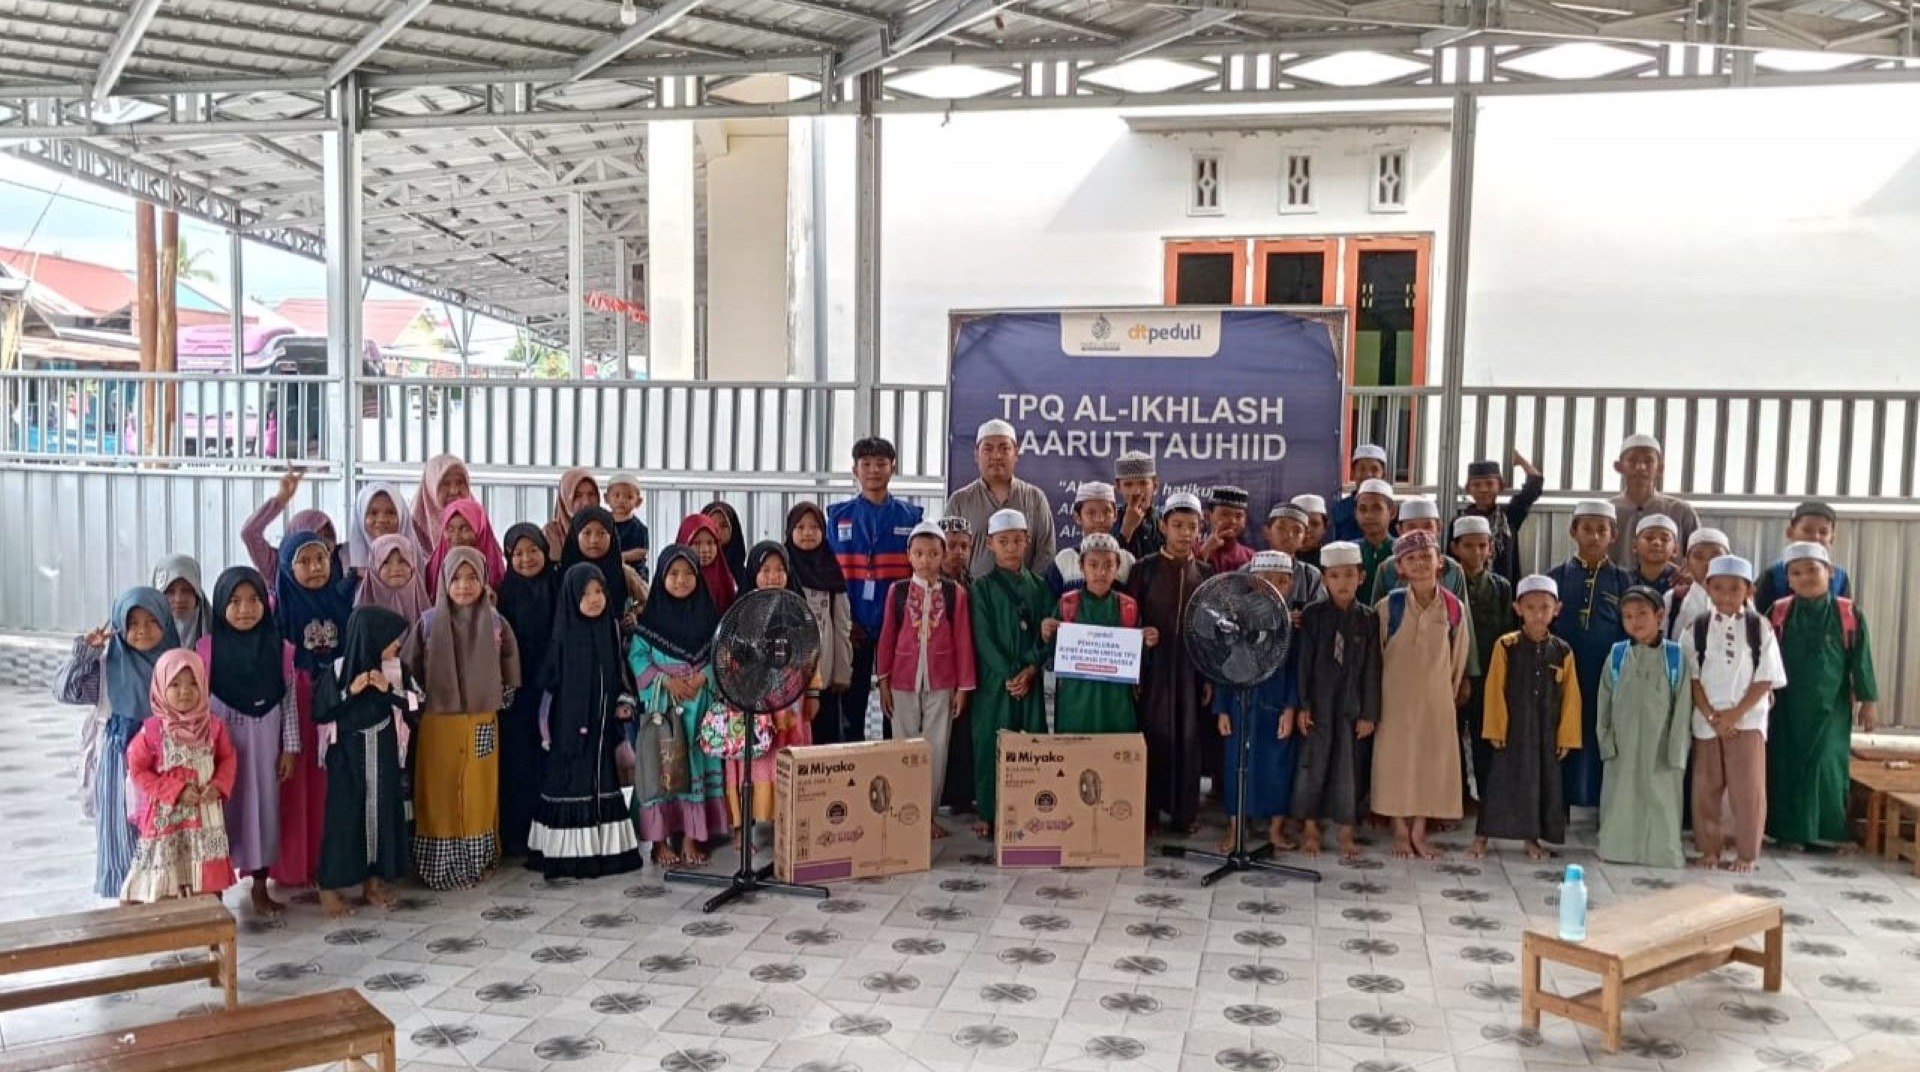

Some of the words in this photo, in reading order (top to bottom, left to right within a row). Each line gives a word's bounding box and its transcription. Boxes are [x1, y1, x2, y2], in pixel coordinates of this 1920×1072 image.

[998, 394, 1065, 423] TPQ
[1074, 395, 1284, 424] AL-IKHLASH
[1018, 430, 1134, 459] AARUT
[1143, 431, 1287, 461] TAUHIID
[811, 760, 856, 776] Miyako
[1018, 750, 1064, 766] Miyako
